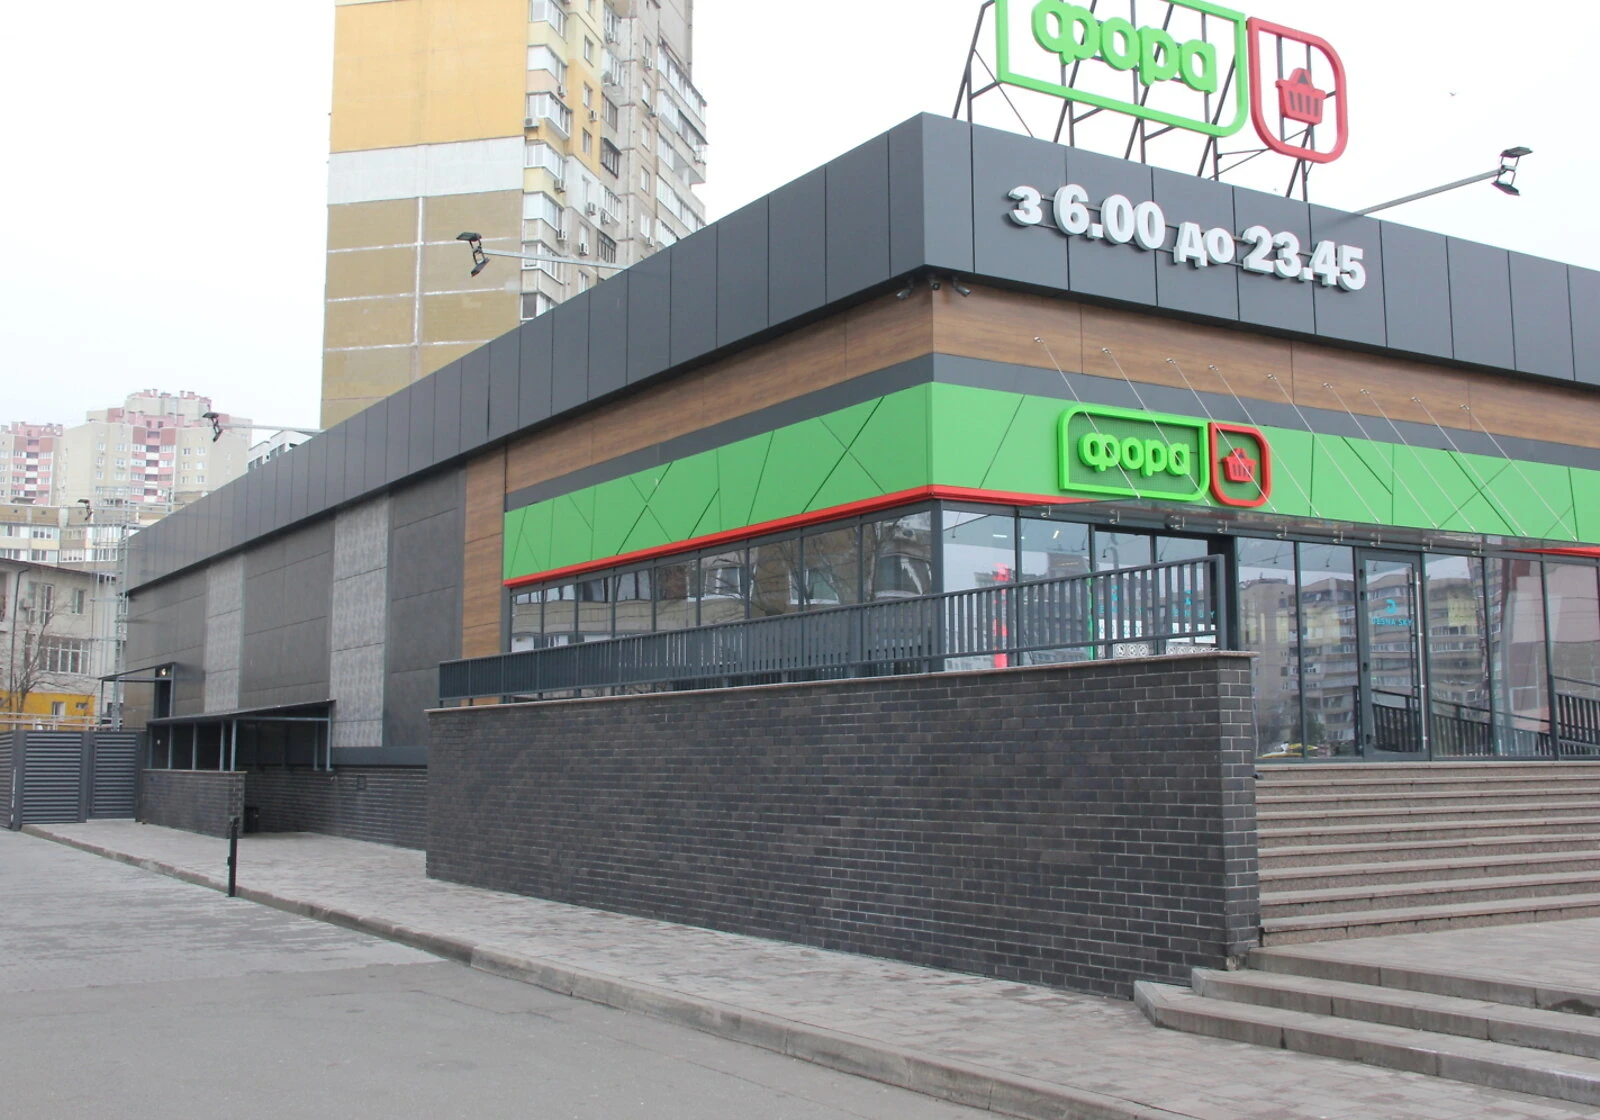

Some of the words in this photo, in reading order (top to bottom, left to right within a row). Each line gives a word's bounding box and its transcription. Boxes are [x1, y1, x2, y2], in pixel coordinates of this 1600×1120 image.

[1031, 0, 1217, 94] фора
[1053, 183, 1166, 250] 6.00
[1173, 222, 1235, 267] до
[1242, 225, 1366, 292] 23.45
[1077, 432, 1190, 477] фора
